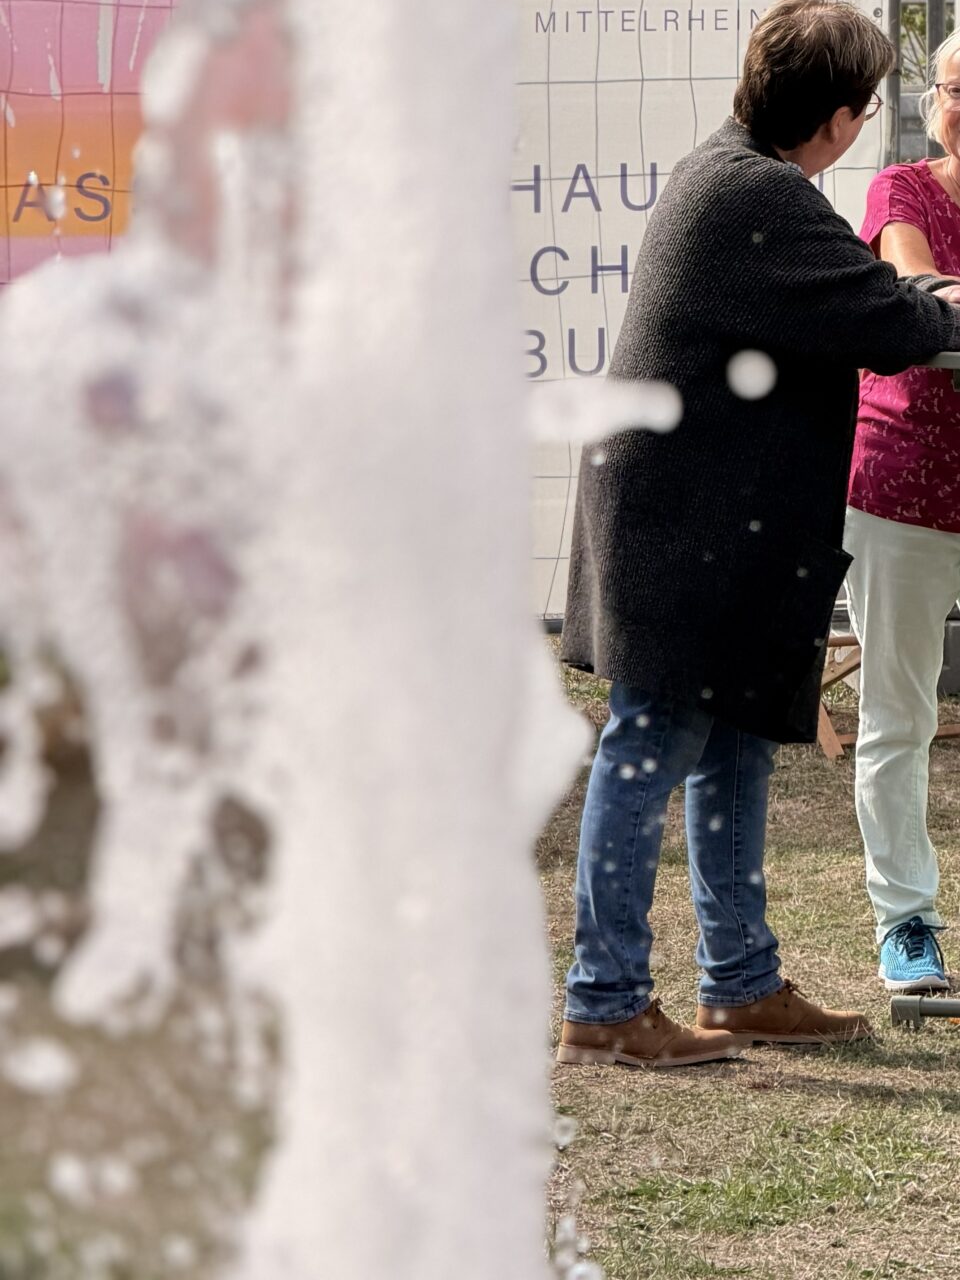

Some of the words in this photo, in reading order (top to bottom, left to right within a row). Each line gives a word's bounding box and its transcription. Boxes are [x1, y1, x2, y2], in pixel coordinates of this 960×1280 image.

[535, 9, 768, 33] MITTELRHEIN
[12, 172, 111, 222] AS
[511, 162, 658, 213] HAU
[530, 245, 628, 296] CH
[525, 327, 606, 378] BU
